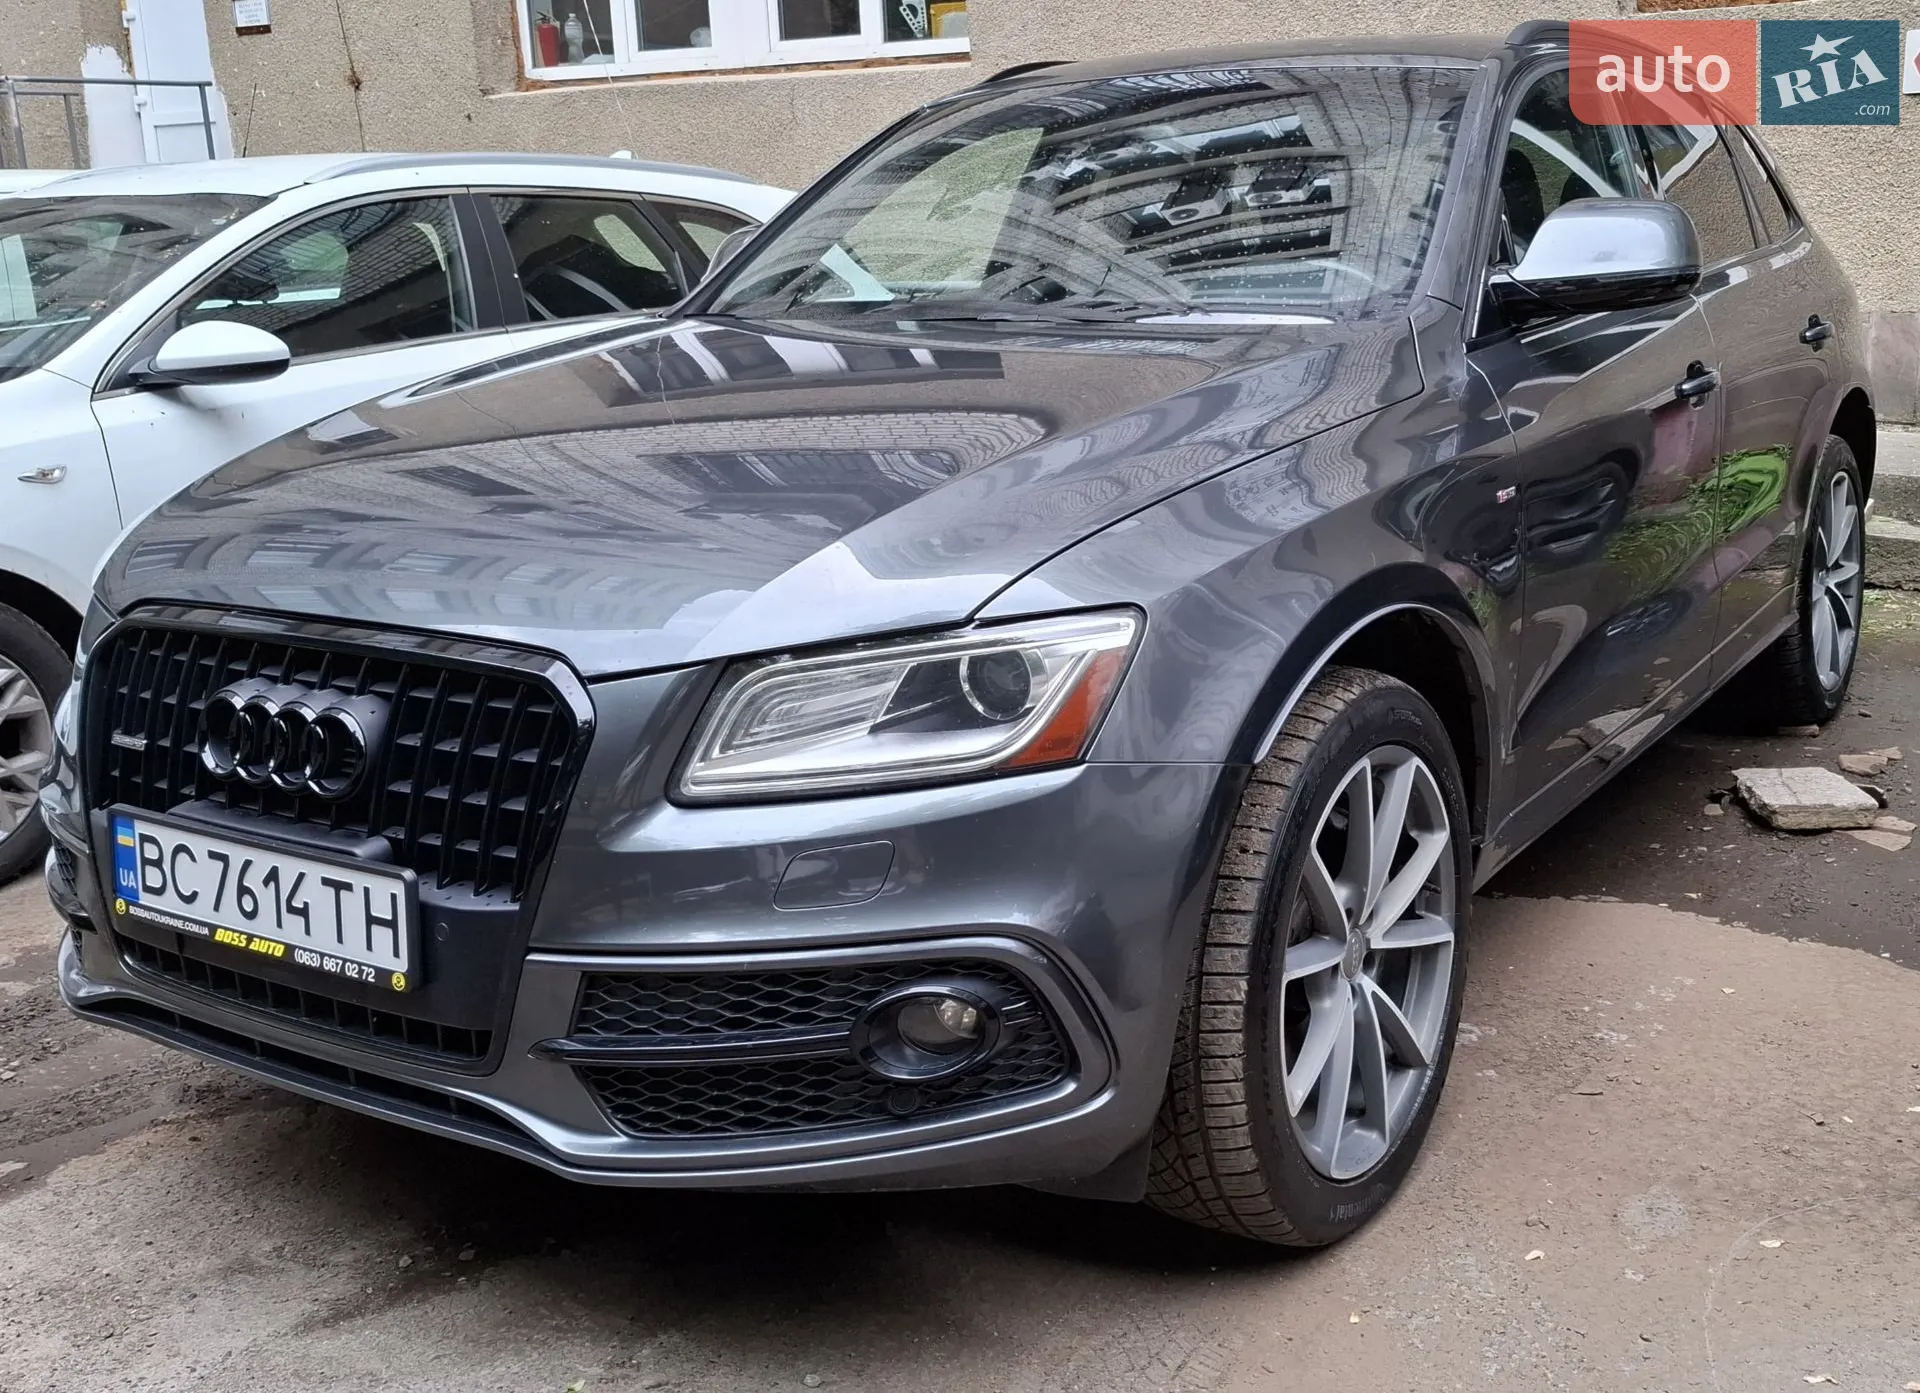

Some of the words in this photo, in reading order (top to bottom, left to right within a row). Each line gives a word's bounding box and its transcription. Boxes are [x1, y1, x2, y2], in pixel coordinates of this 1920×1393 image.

[119, 867, 137, 889] UA
[214, 928, 248, 947] BOSS
[294, 947, 321, 968] (063)
[323, 956, 343, 974] 667
[345, 962, 360, 978] 02
[361, 966, 377, 982] 72
